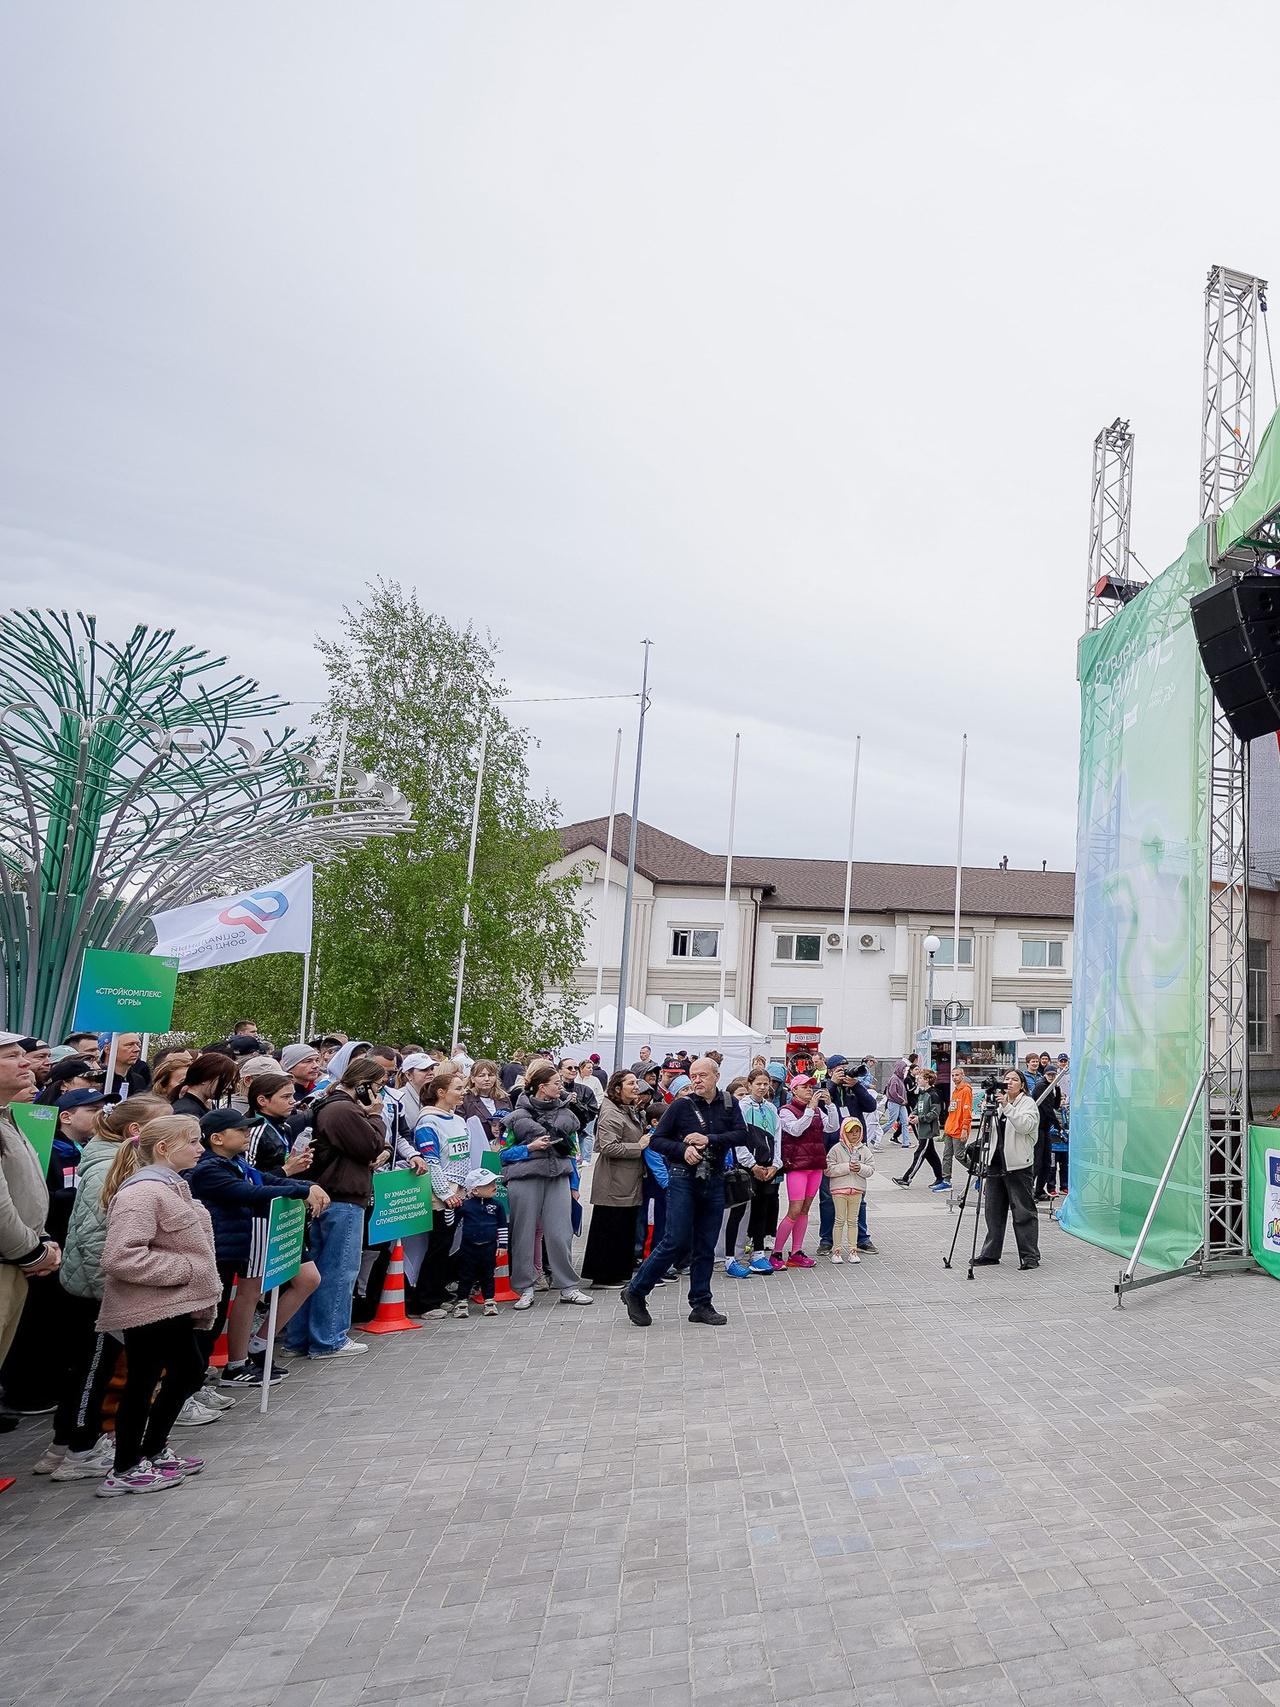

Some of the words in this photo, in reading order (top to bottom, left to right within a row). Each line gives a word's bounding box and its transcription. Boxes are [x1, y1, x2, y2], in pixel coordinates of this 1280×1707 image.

[96, 987, 162, 998] «СТРОЙКОМПЛЕКС
[117, 998, 142, 1006] ЮГРЫ»
[452, 1142, 469, 1153] 1399
